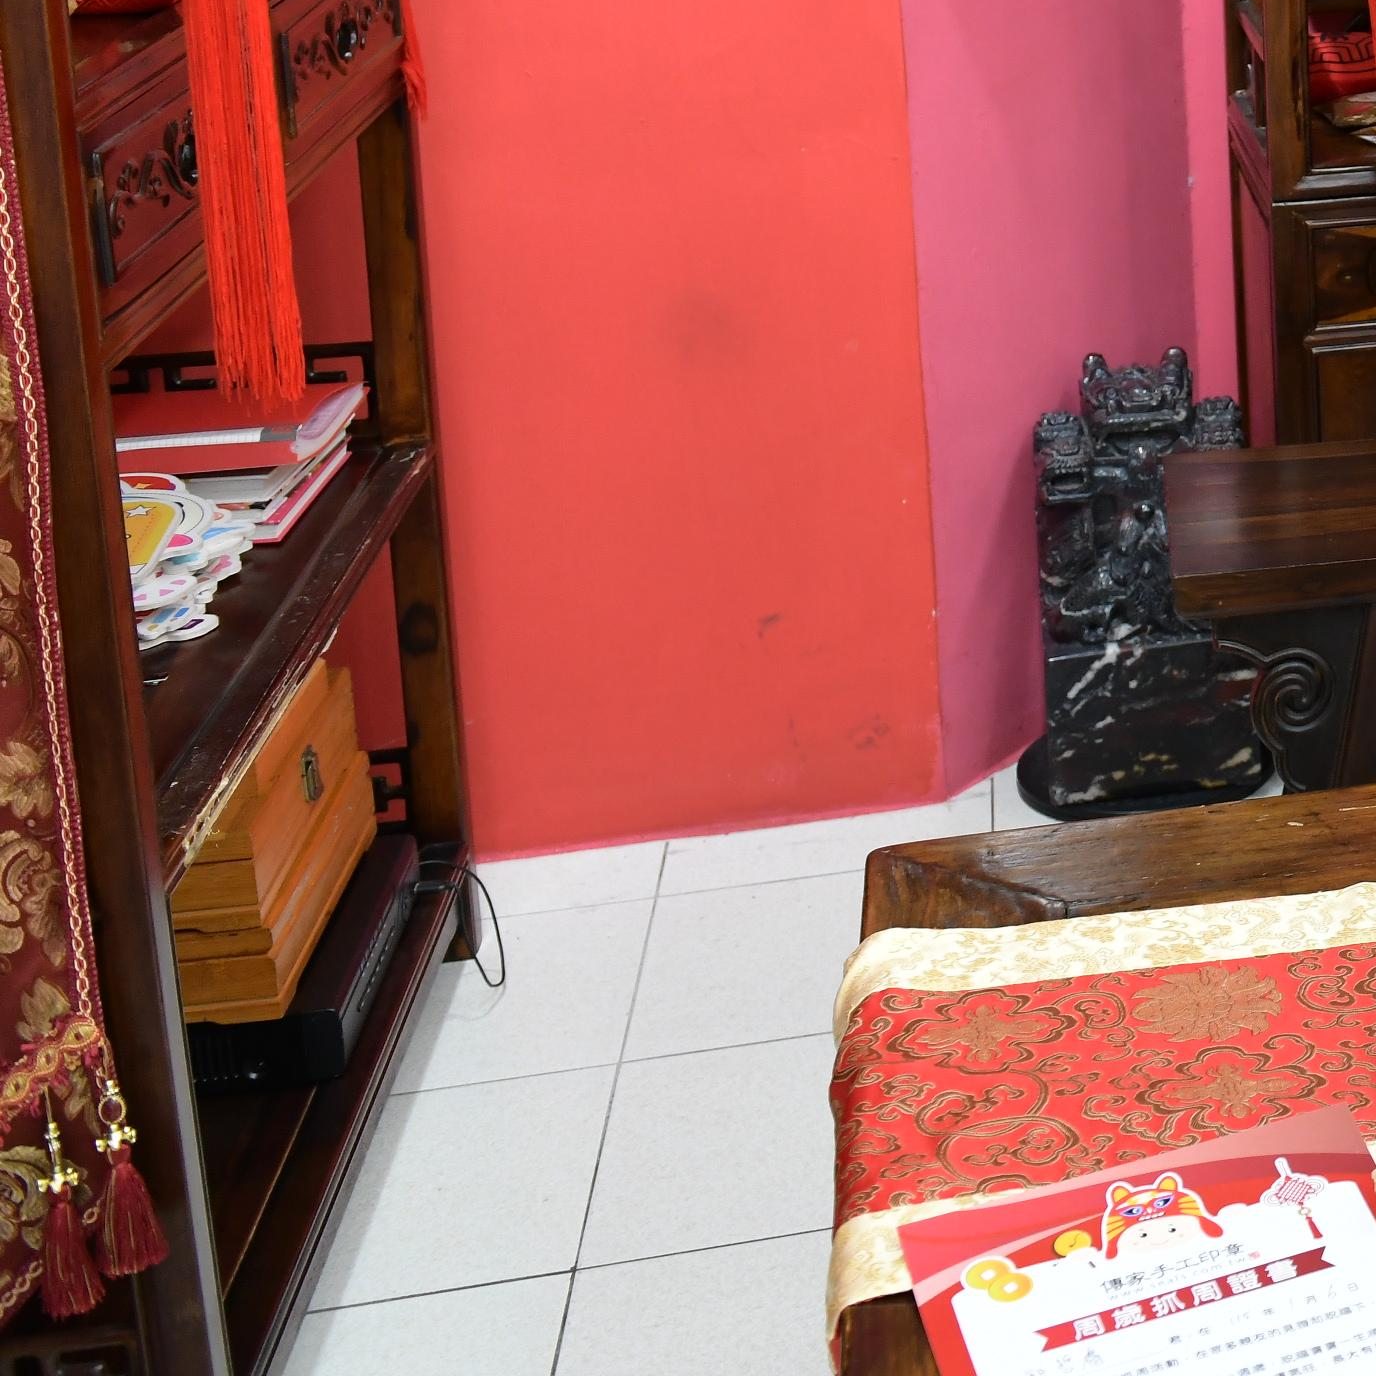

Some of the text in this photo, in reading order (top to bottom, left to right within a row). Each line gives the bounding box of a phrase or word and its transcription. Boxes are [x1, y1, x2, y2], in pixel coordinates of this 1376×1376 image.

[1072, 1258, 1300, 1342] 周歲抓周證書
